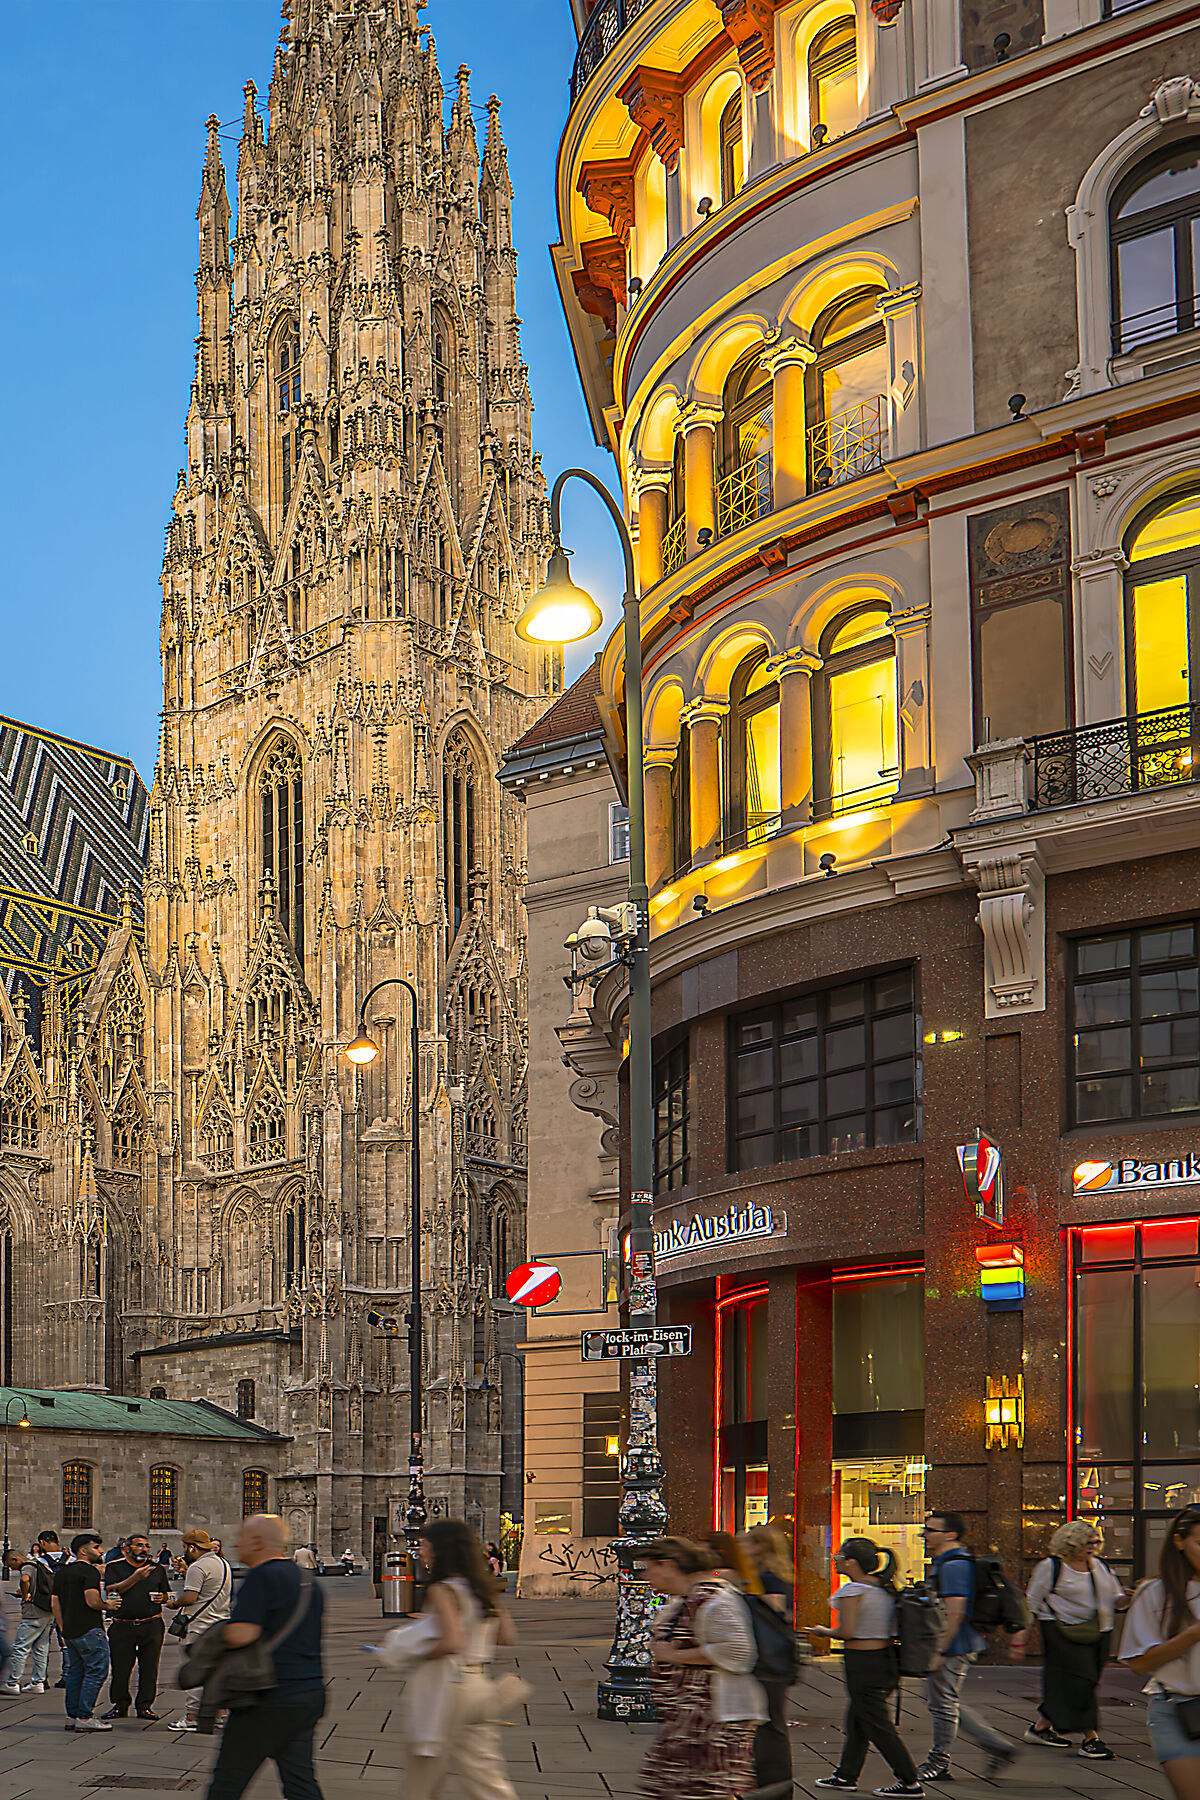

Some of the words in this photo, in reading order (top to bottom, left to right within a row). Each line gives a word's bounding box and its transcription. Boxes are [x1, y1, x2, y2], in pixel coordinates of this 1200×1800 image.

[1118, 1152, 1200, 1185] Bank
[653, 1219, 686, 1252] ank
[688, 1201, 773, 1245] Austria
[622, 1343, 648, 1356] Plat
